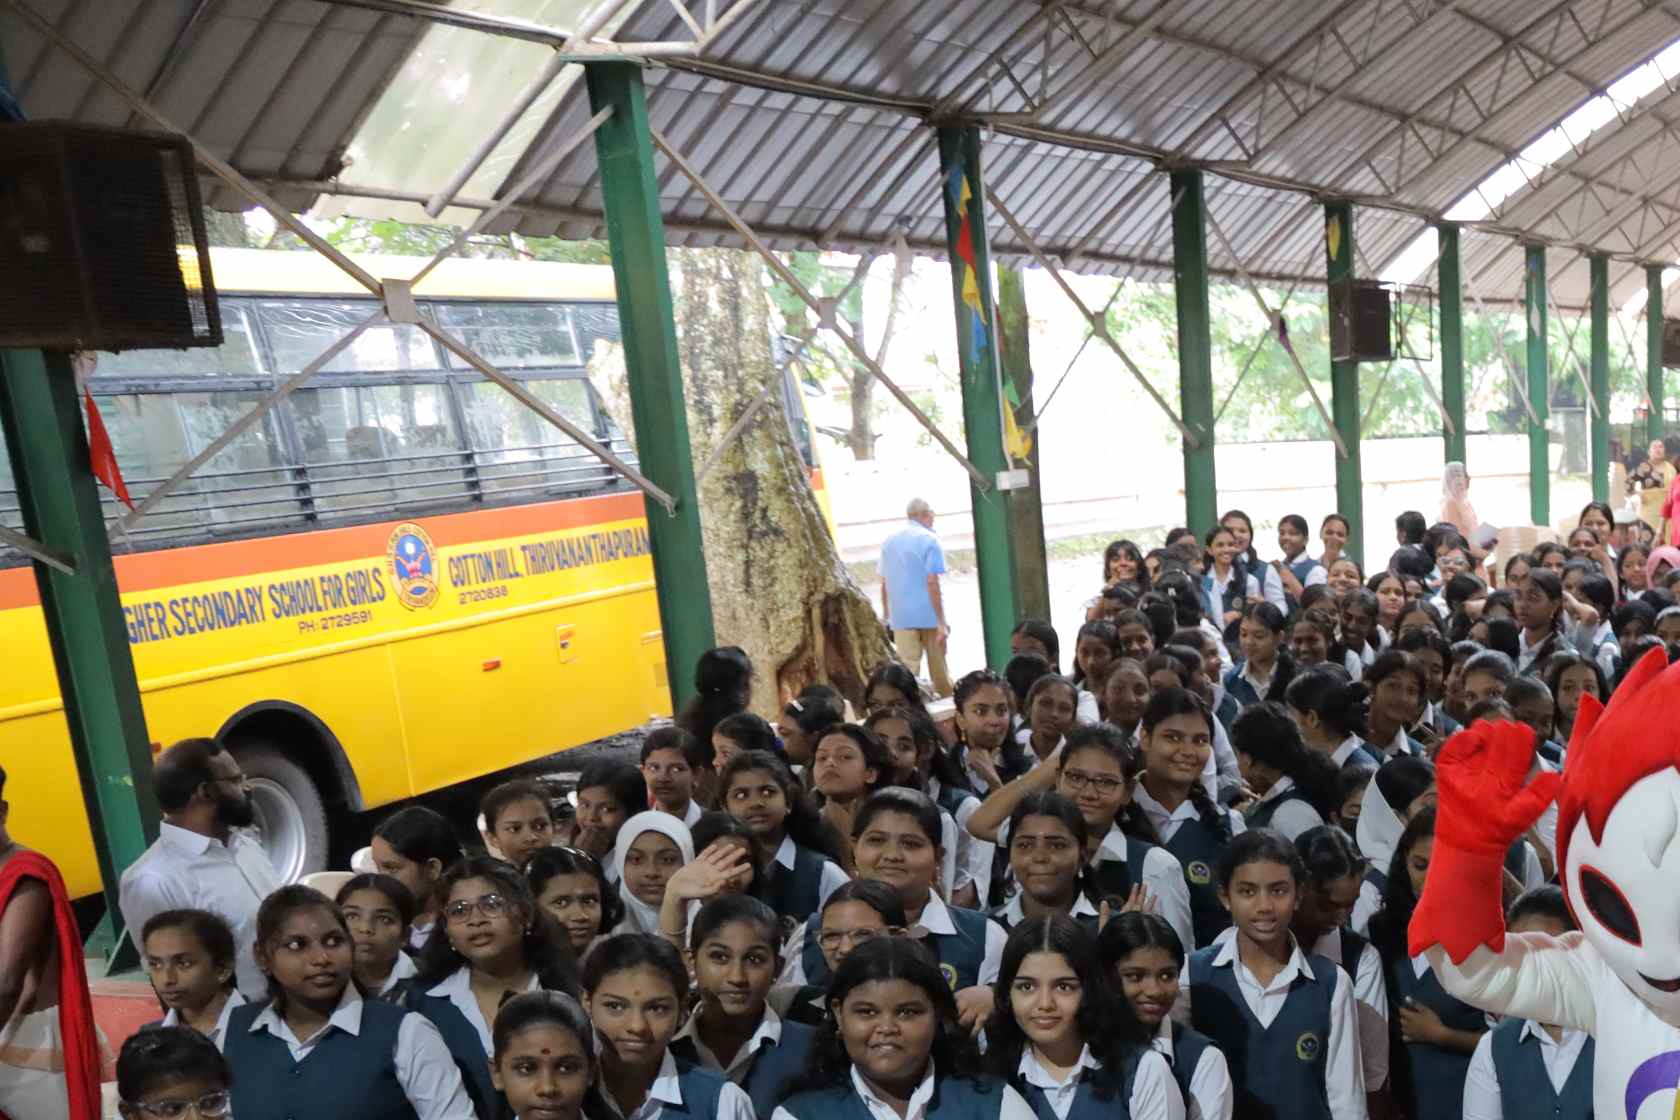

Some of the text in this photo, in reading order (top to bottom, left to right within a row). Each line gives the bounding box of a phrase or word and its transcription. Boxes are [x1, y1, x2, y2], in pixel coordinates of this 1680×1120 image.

[448, 552, 494, 587] COTTON
[169, 585, 266, 637] SECONDARY
[268, 577, 322, 619] SCHOOL
[322, 574, 346, 612] FOR
[345, 567, 386, 607] GIRLS
